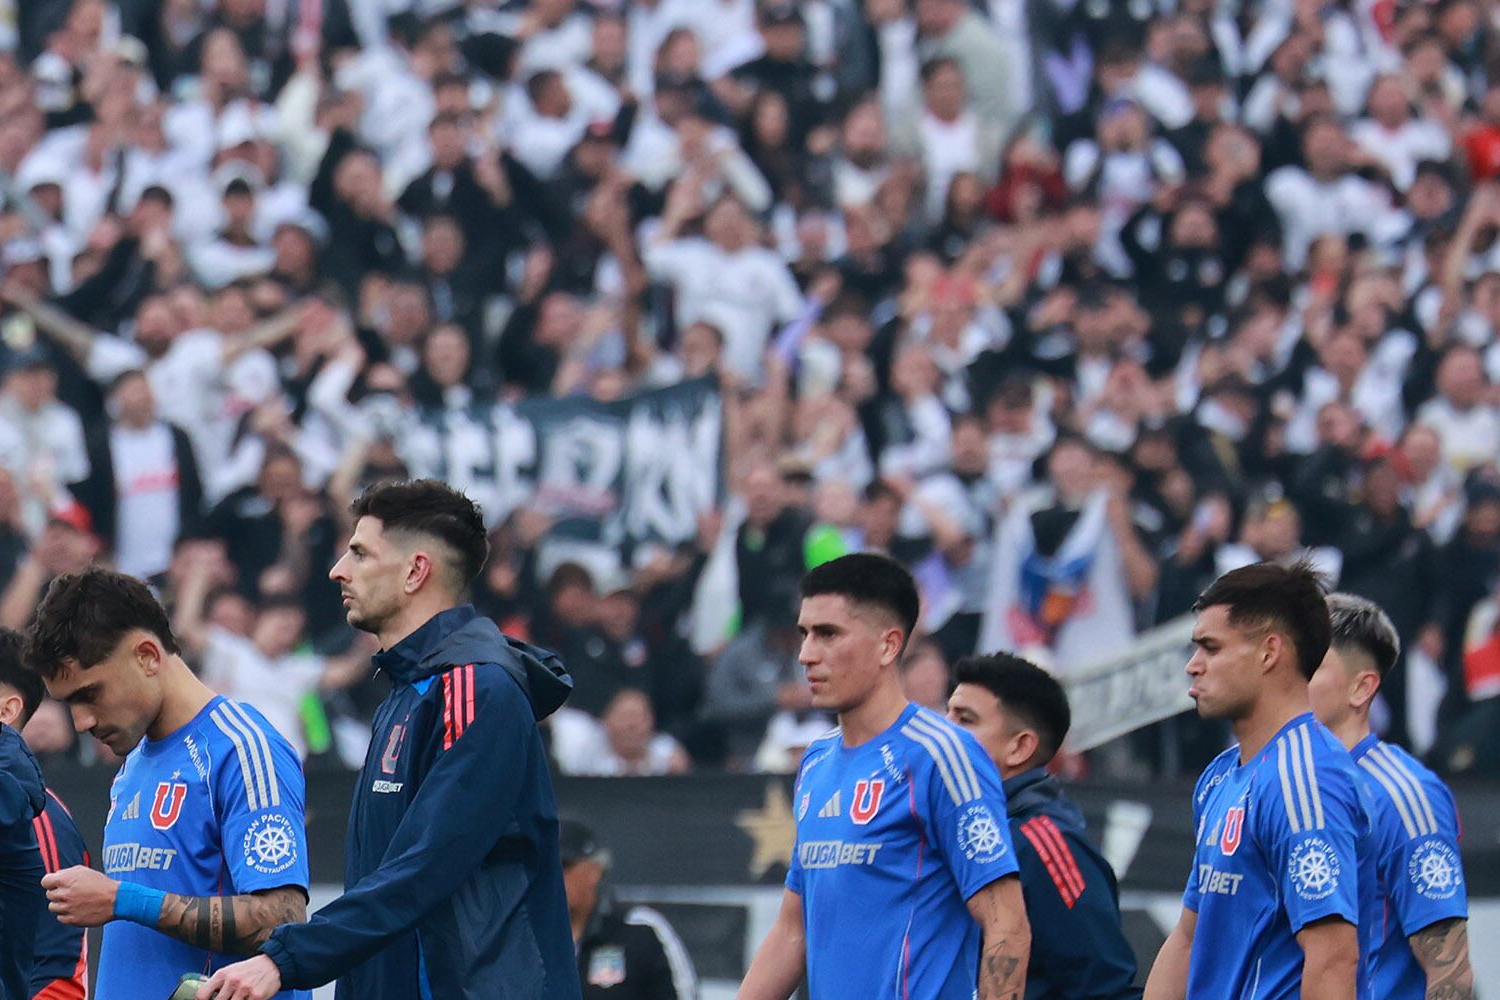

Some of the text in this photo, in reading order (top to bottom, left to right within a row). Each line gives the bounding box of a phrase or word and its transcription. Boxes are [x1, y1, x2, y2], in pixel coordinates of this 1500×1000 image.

[150, 782, 187, 830] U
[850, 778, 885, 825] U
[243, 819, 260, 856] OCEAN
[800, 840, 883, 869] JUGABET
[1221, 807, 1245, 856] U
